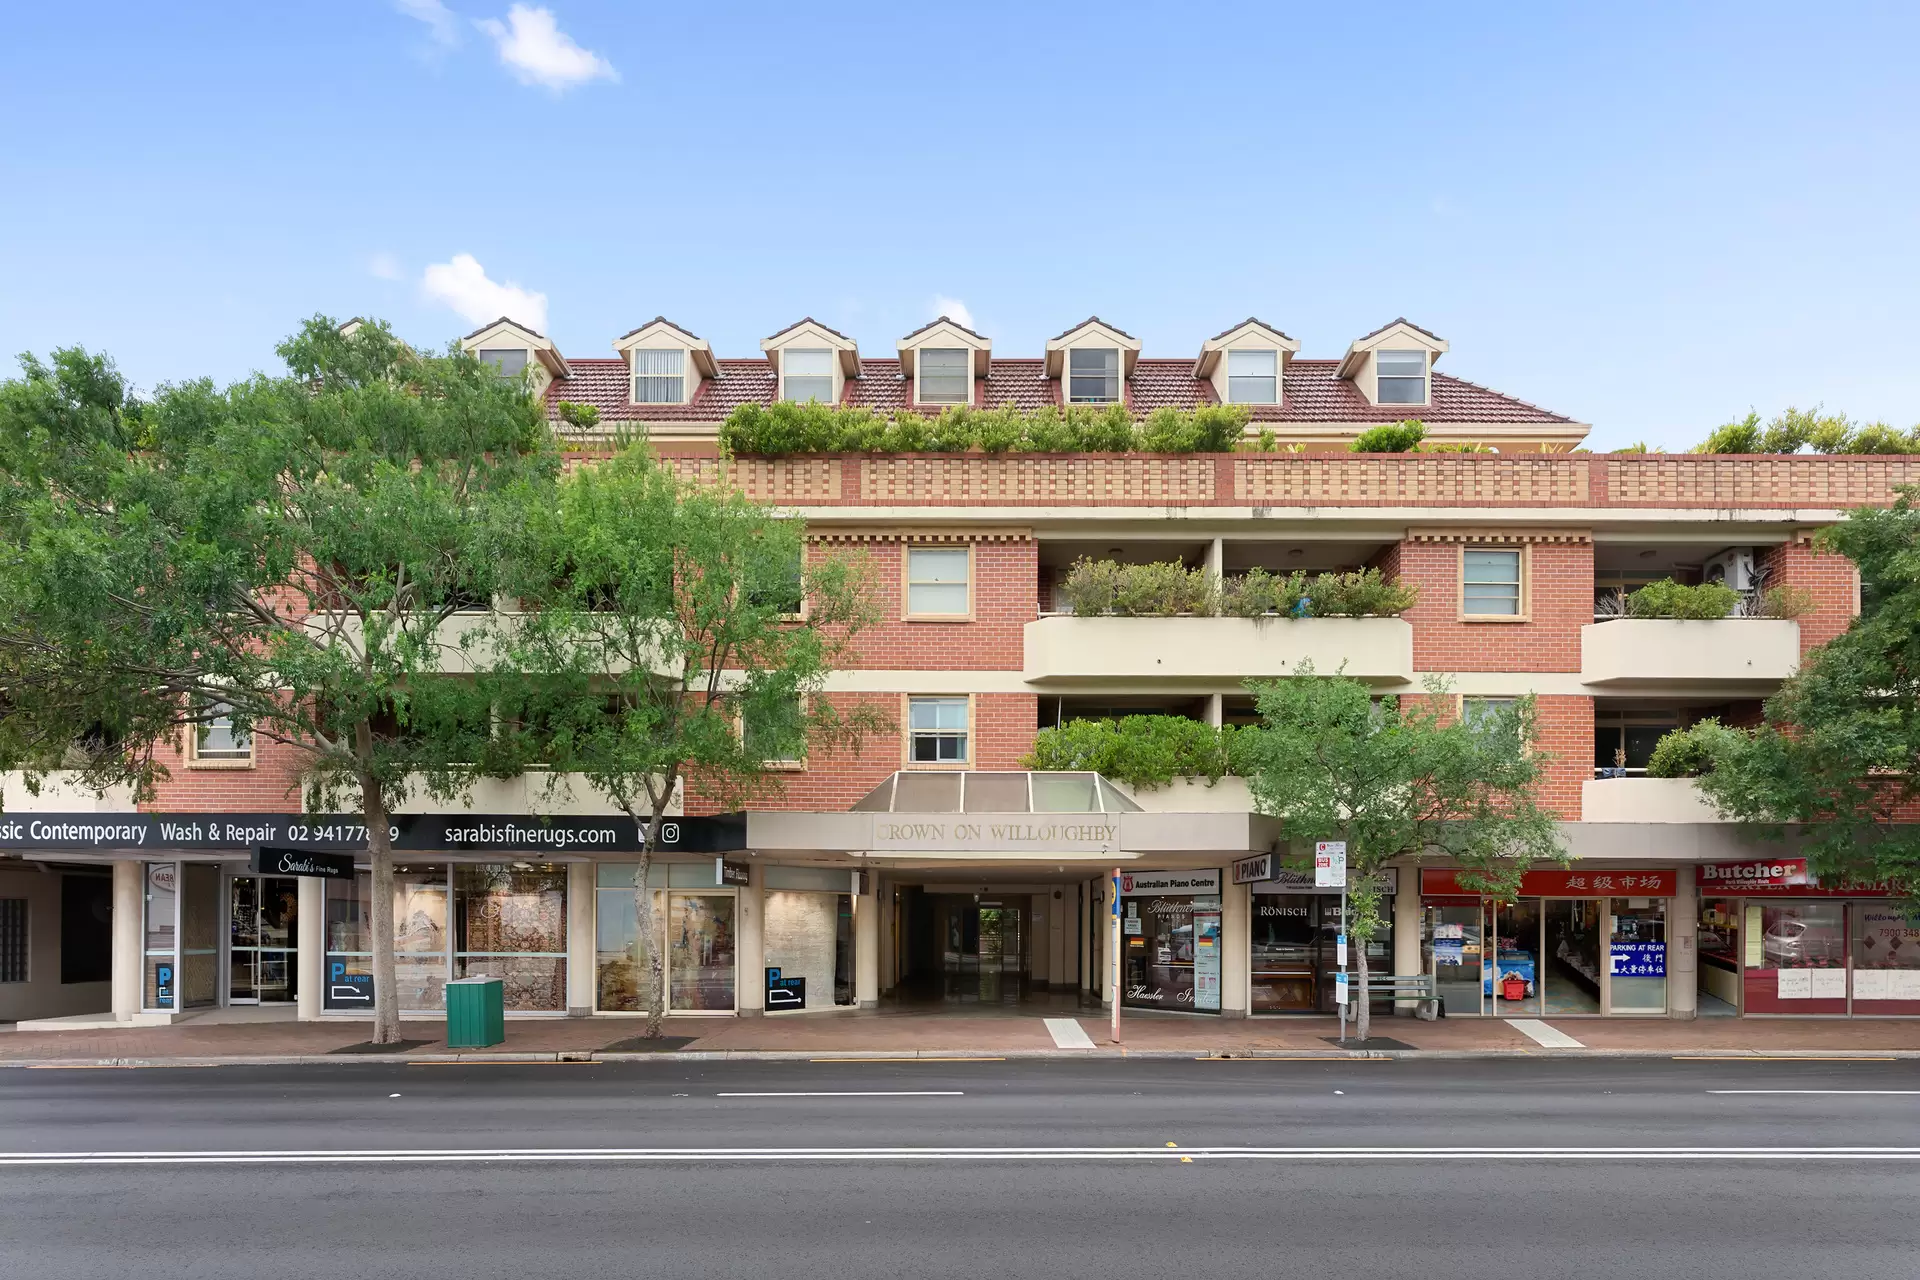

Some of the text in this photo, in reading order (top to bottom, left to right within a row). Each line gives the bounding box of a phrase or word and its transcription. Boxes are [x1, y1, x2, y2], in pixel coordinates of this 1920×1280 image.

[30, 821, 147, 845] Contemporary
[160, 823, 276, 844] Wash & Repair
[288, 826, 399, 842] 02 9417789
[445, 824, 616, 847] sarabisfinerugs.com
[954, 824, 981, 840] ON
[991, 824, 1117, 841] WILLOUGHBY
[1241, 859, 1266, 879] PIANO
[1703, 863, 1796, 879] Butcher
[1135, 880, 1168, 888] Australian
[1190, 879, 1215, 887] Centre
[1565, 875, 1662, 890] 超级市场
[1260, 906, 1308, 916] RÖNISCH
[1879, 928, 1901, 937] 7900
[1610, 944, 1664, 952] PARKING AT REAR
[159, 967, 172, 986] P
[331, 962, 344, 982] P
[769, 968, 780, 988] P
